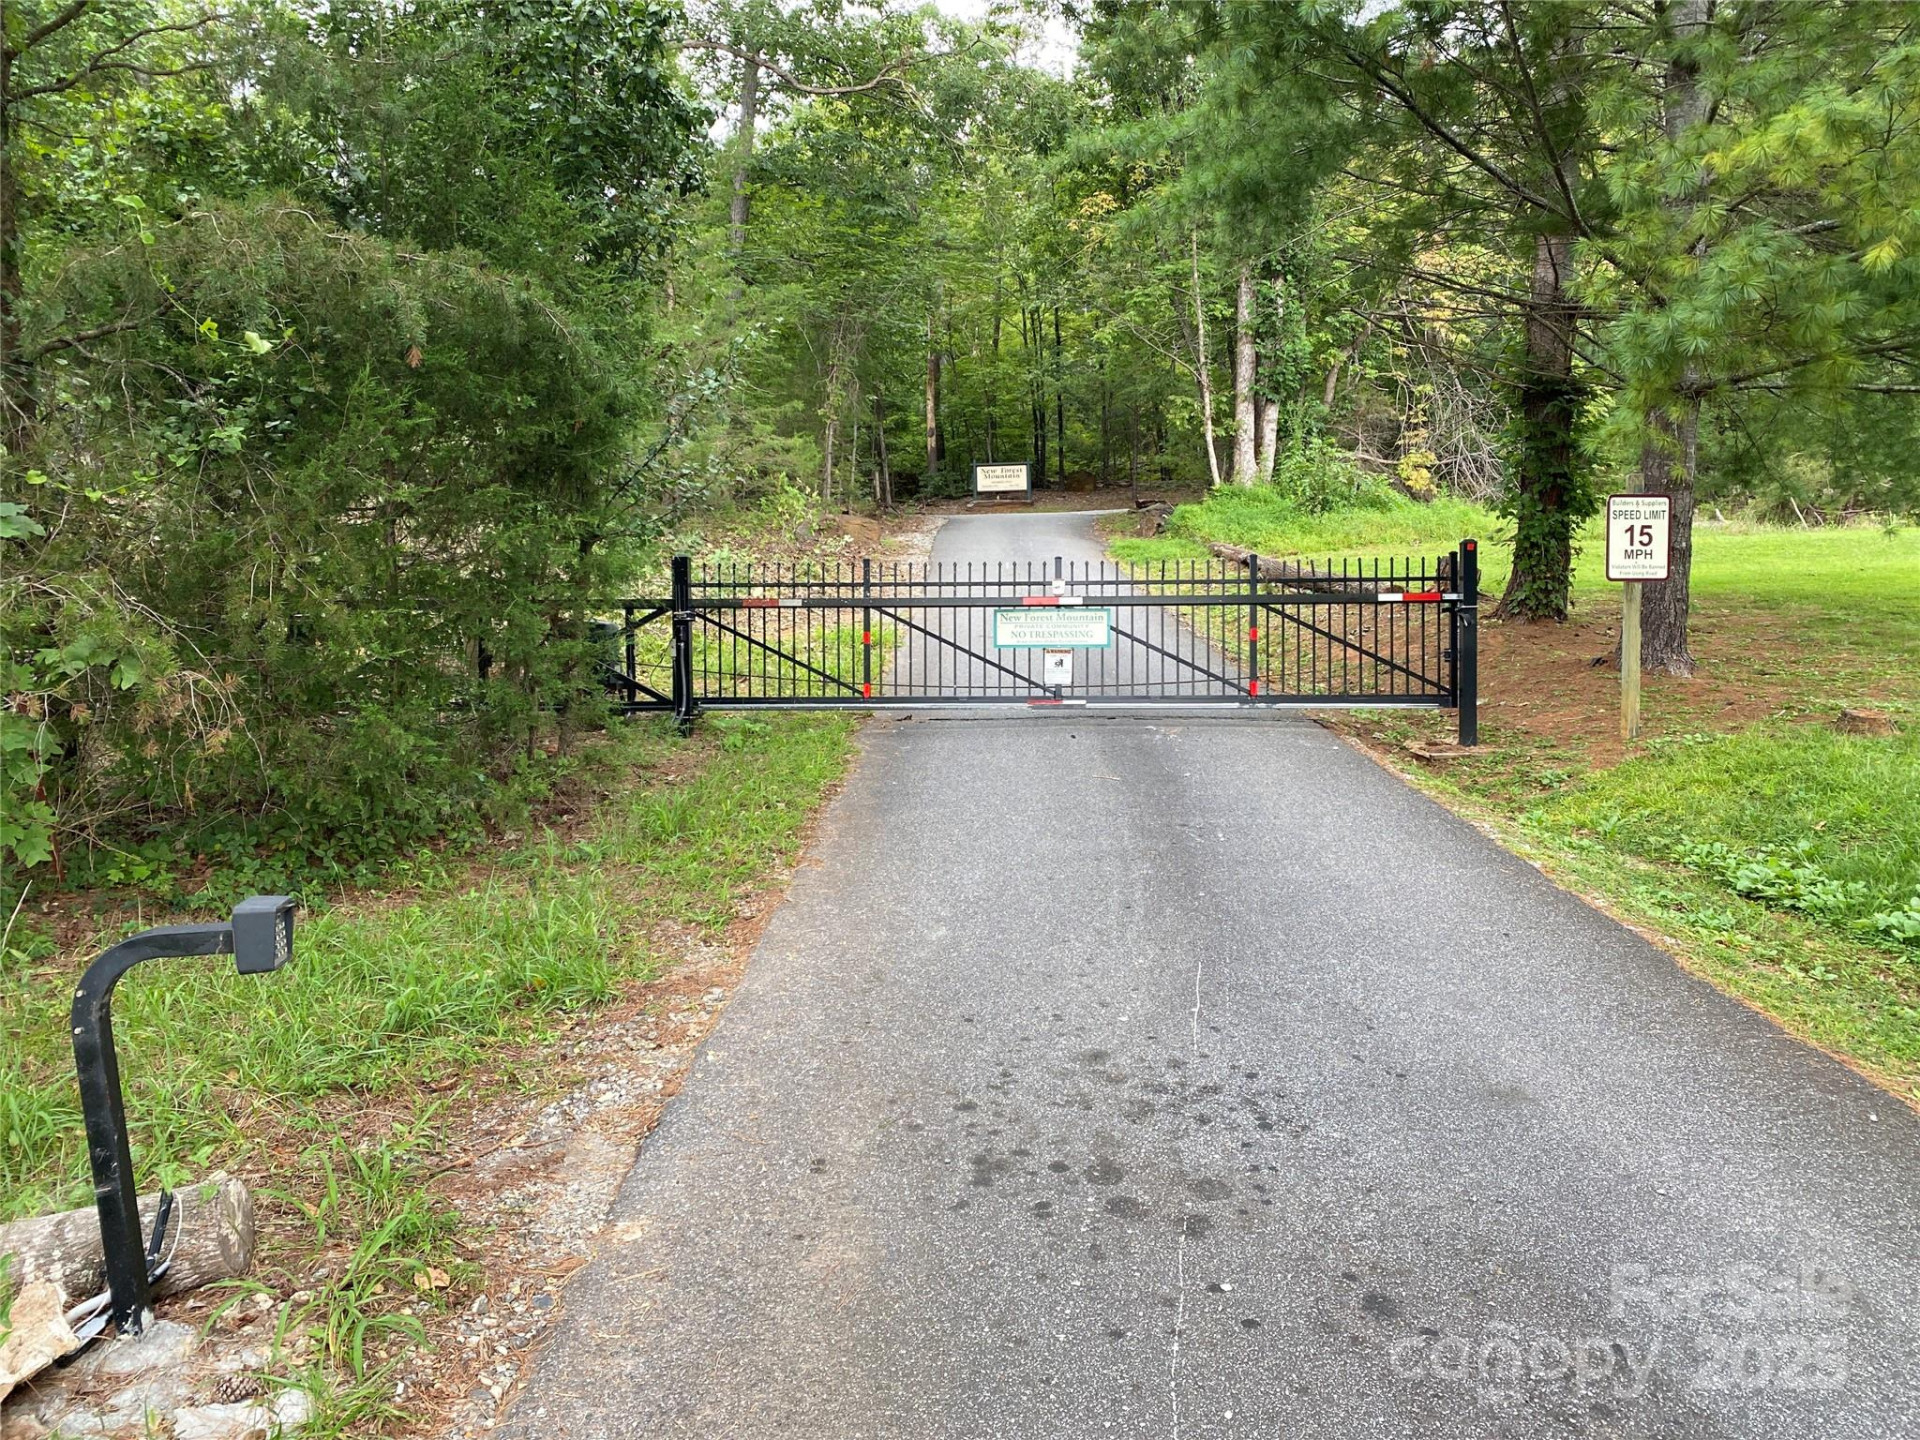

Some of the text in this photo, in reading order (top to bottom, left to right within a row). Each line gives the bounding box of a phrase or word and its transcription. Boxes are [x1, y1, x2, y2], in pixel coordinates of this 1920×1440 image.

[1641, 499, 1667, 507] Suppliers
[1612, 510, 1666, 520] SPEED LIMIT
[1624, 524, 1653, 547] 15
[1624, 549, 1653, 560] MPH
[1000, 613, 1104, 622] New Forest Mountain
[1011, 630, 1093, 639] NO TRESPASSING
